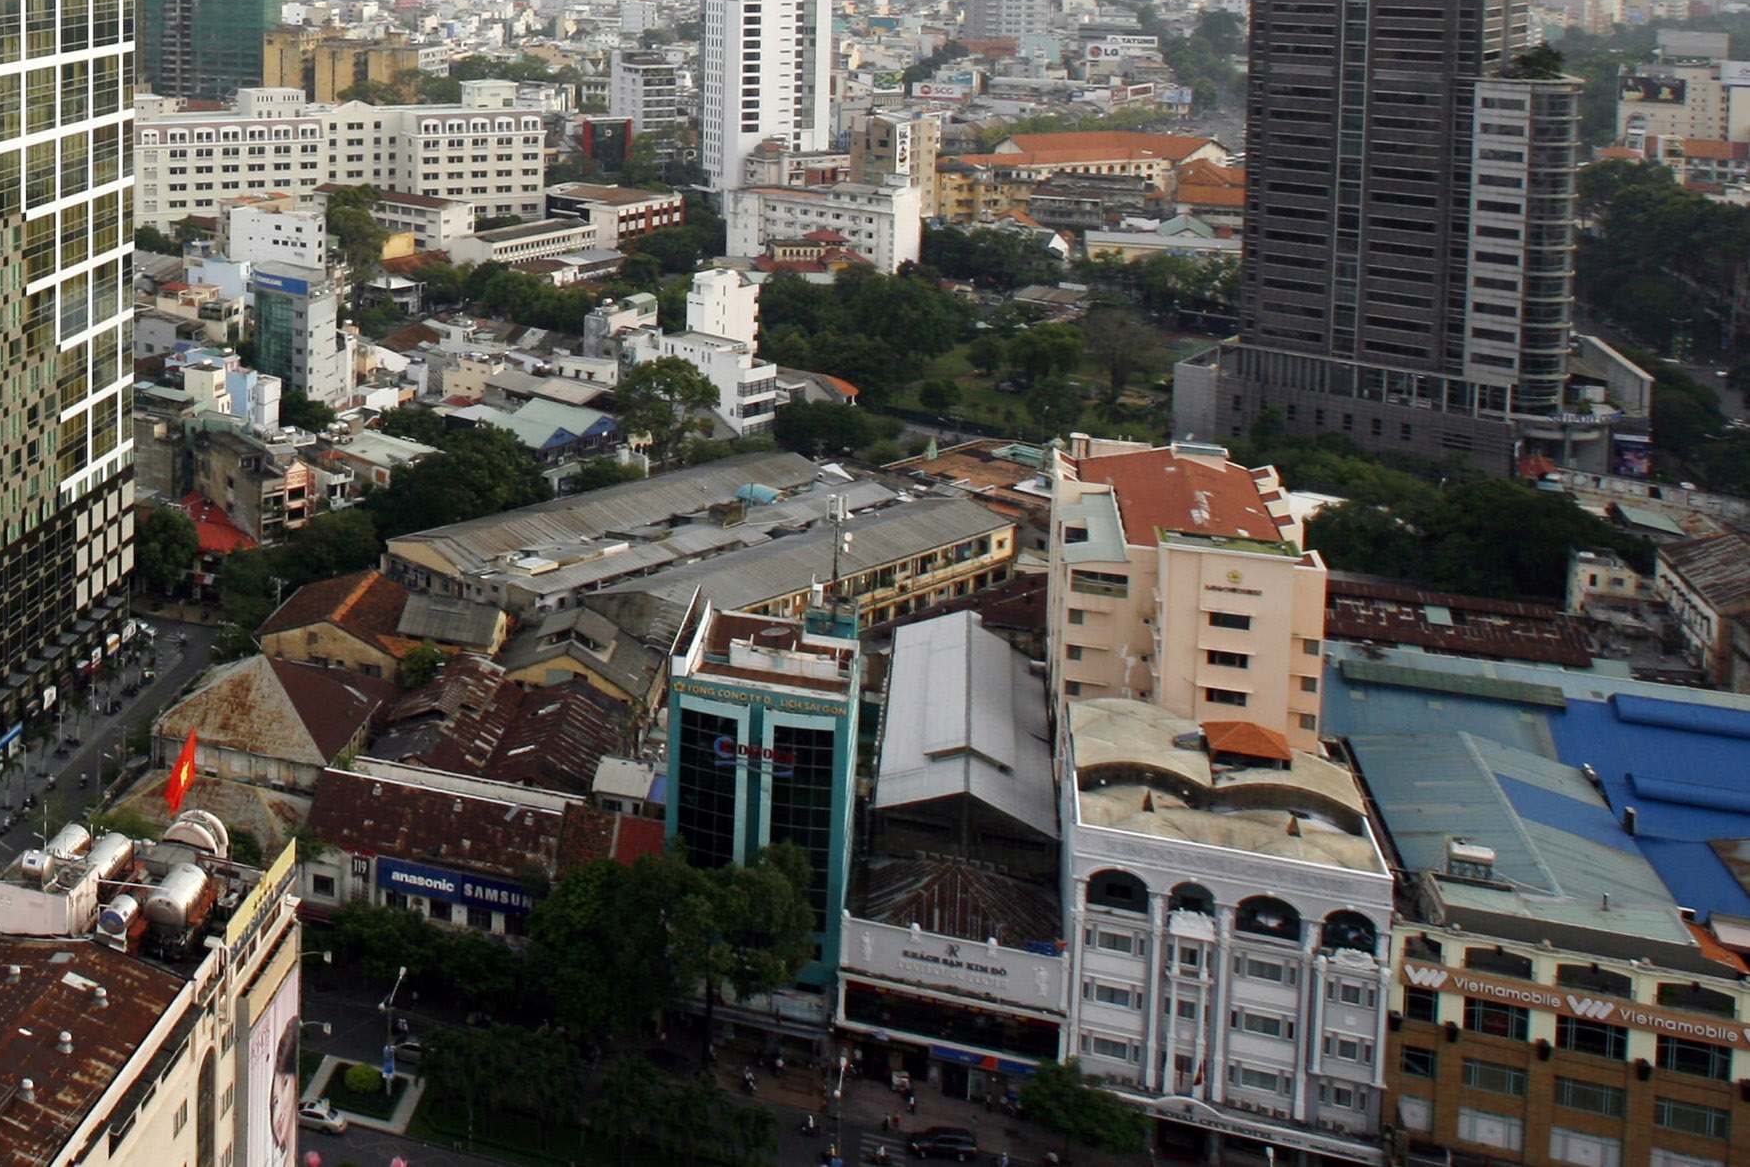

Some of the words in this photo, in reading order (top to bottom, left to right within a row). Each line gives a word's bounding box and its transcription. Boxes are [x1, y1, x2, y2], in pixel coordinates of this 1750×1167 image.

[1104, 47, 1119, 57] LG
[463, 883, 533, 909] SAMSUN
[1454, 976, 1562, 1007] Vietnamobile
[1619, 1007, 1739, 1042] Vietnamobile
